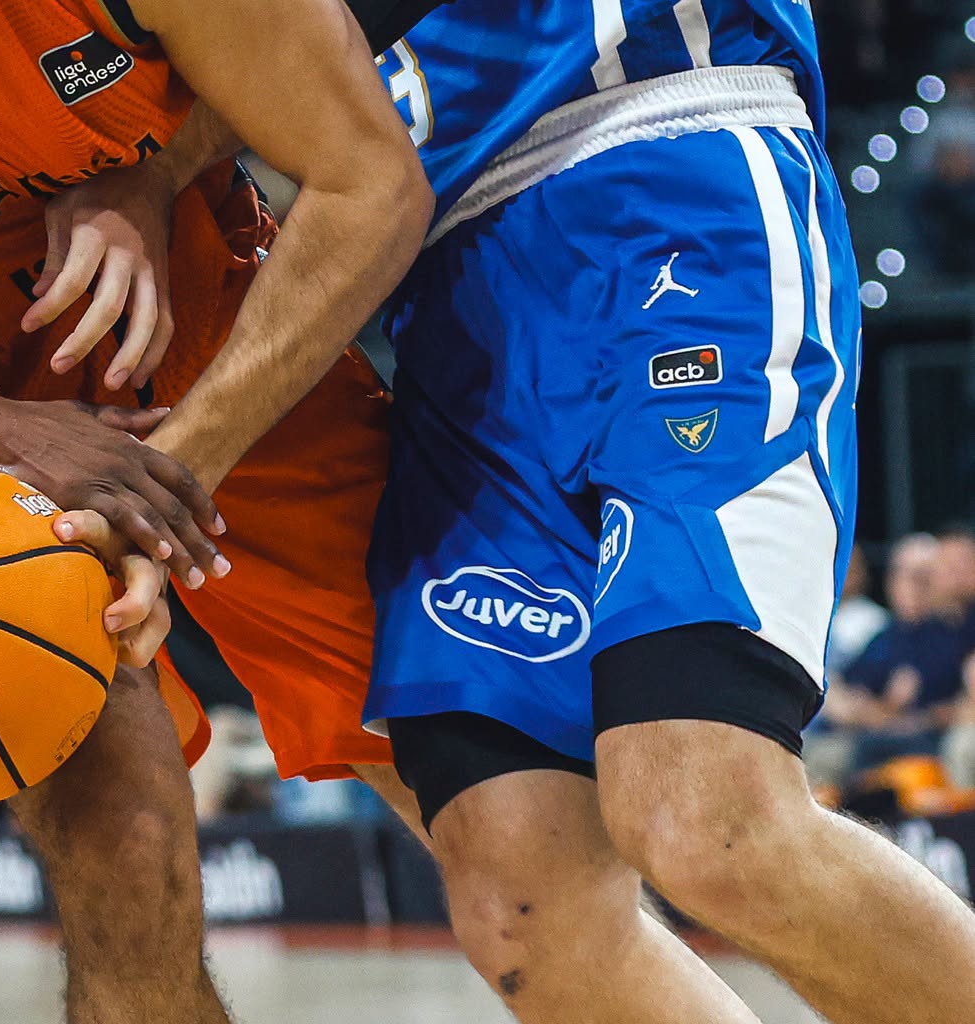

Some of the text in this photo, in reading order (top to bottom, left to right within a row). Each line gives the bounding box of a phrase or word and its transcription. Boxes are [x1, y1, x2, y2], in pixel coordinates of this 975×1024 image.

[54, 61, 87, 82] liga
[64, 53, 128, 94] endesa
[657, 362, 705, 383] acb
[435, 589, 575, 639] Juver
